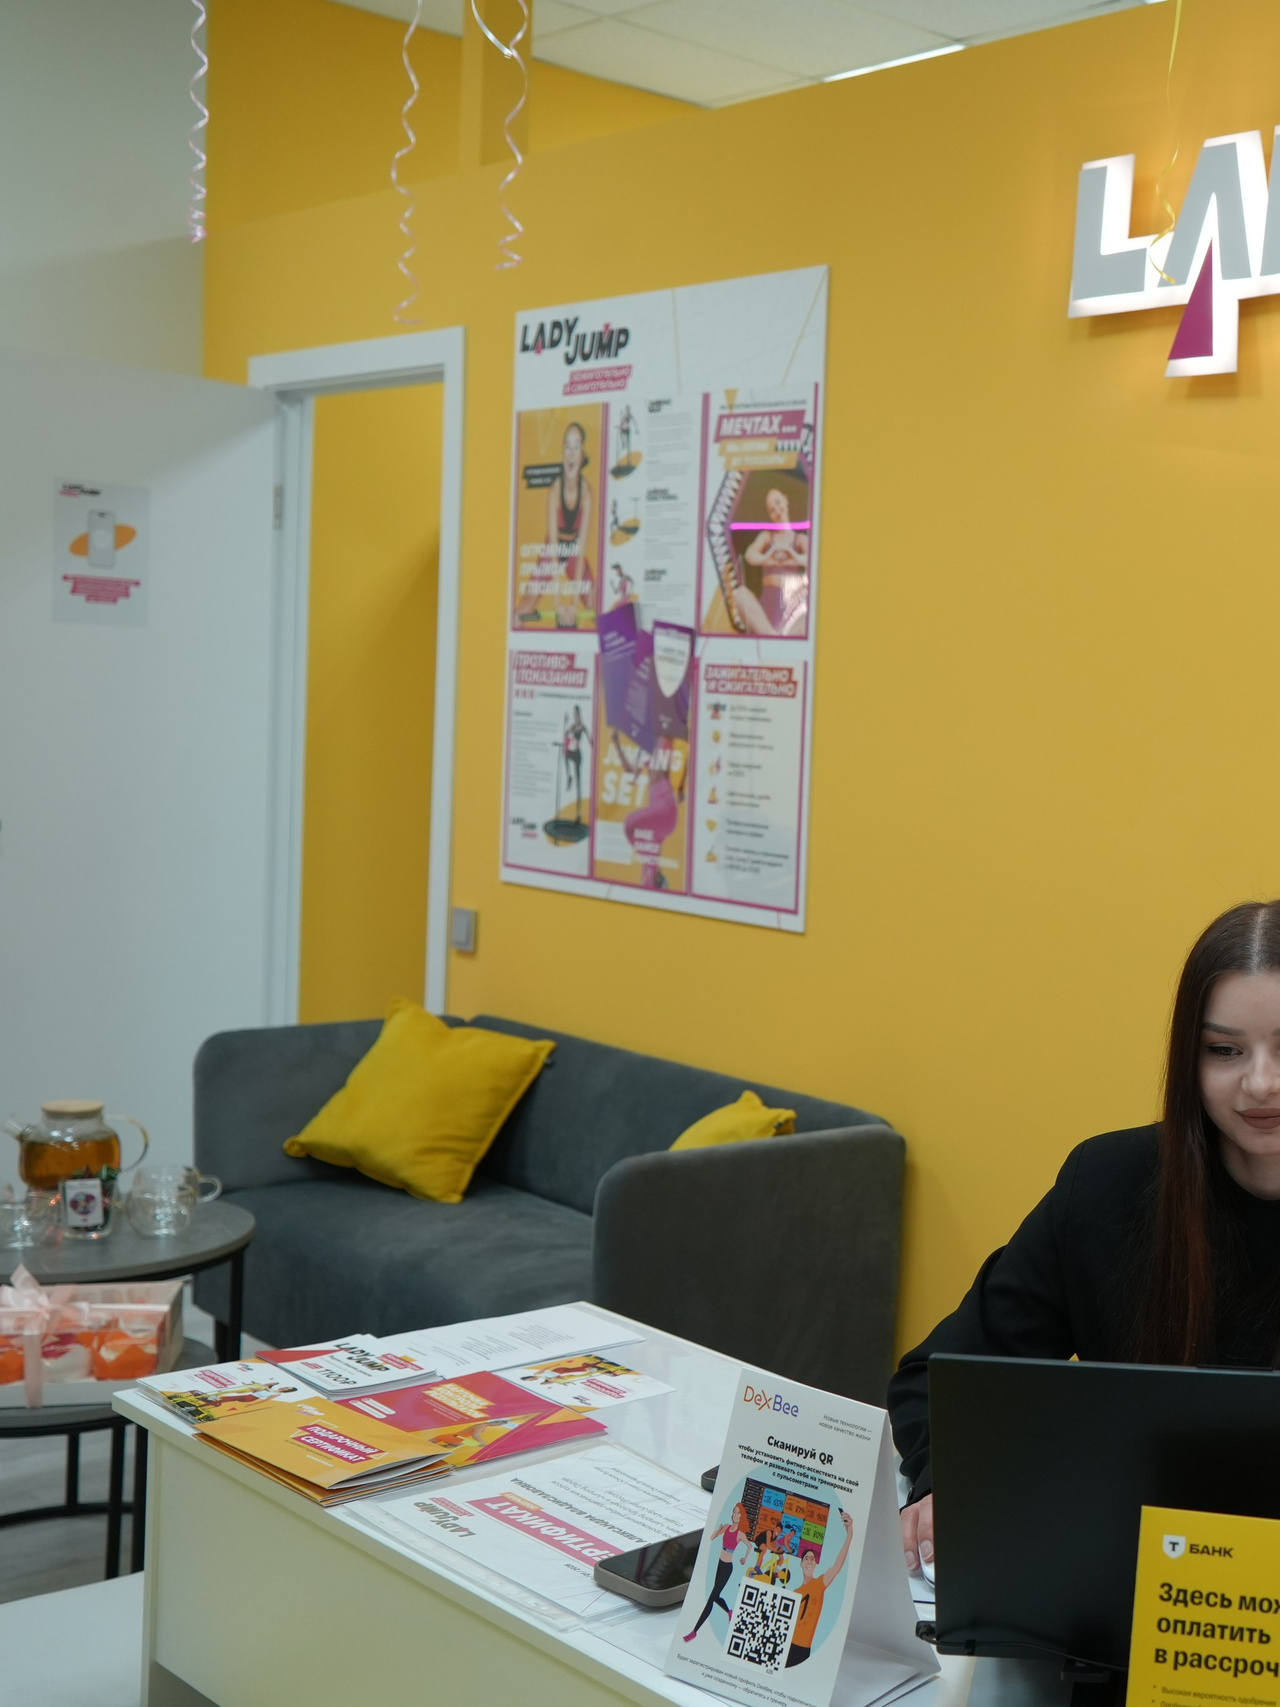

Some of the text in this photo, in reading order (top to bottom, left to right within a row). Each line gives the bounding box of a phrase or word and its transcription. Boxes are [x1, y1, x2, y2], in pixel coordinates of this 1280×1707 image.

[519, 316, 578, 354] LADY
[564, 323, 630, 365] JUMP
[720, 415, 798, 437] МЕЧТАХ...
[601, 770, 650, 808] SET
[334, 1343, 375, 1358] LADY
[347, 1356, 390, 1372] JUMP
[819, 1421, 871, 1441] новое качество жизни
[823, 1414, 839, 1424] Новые
[839, 1419, 867, 1432] технологии
[300, 1435, 366, 1461] СЕРТИФИКАТ
[306, 1426, 379, 1454] ПОДАРОЧНЫЙ
[767, 1435, 834, 1465] Сканируй QR
[738, 1444, 754, 1452] чтобы
[755, 1448, 785, 1463] установить
[786, 1459, 837, 1480] фитнес-ассистента
[846, 1478, 859, 1487] свой
[741, 1453, 763, 1465] телефон
[769, 1461, 796, 1475] развивать
[796, 1471, 809, 1479] себя
[817, 1477, 853, 1494] тренировках
[776, 1472, 819, 1490] пульсометрами
[510, 1477, 588, 1516] ВЛАДИСЛАВОВНА
[413, 1501, 460, 1522] JUMP
[430, 1519, 476, 1538] LADY
[483, 1501, 616, 1561] ЕРТИФИКАТ
[584, 1514, 647, 1543] АЛЕКСАНДРА
[1189, 1543, 1234, 1558] БАНК
[1158, 1582, 1232, 1608] Здесь
[1156, 1616, 1271, 1644] оплатить
[1154, 1648, 1167, 1664] в
[677, 1653, 689, 1662] Будет
[689, 1658, 724, 1675] зарегистрирован
[724, 1671, 739, 1681] новый
[739, 1676, 756, 1688] профиль
[774, 1690, 787, 1699] чтобы
[1162, 1686, 1191, 1696] Высокая
[1193, 1691, 1237, 1702] вероятность
